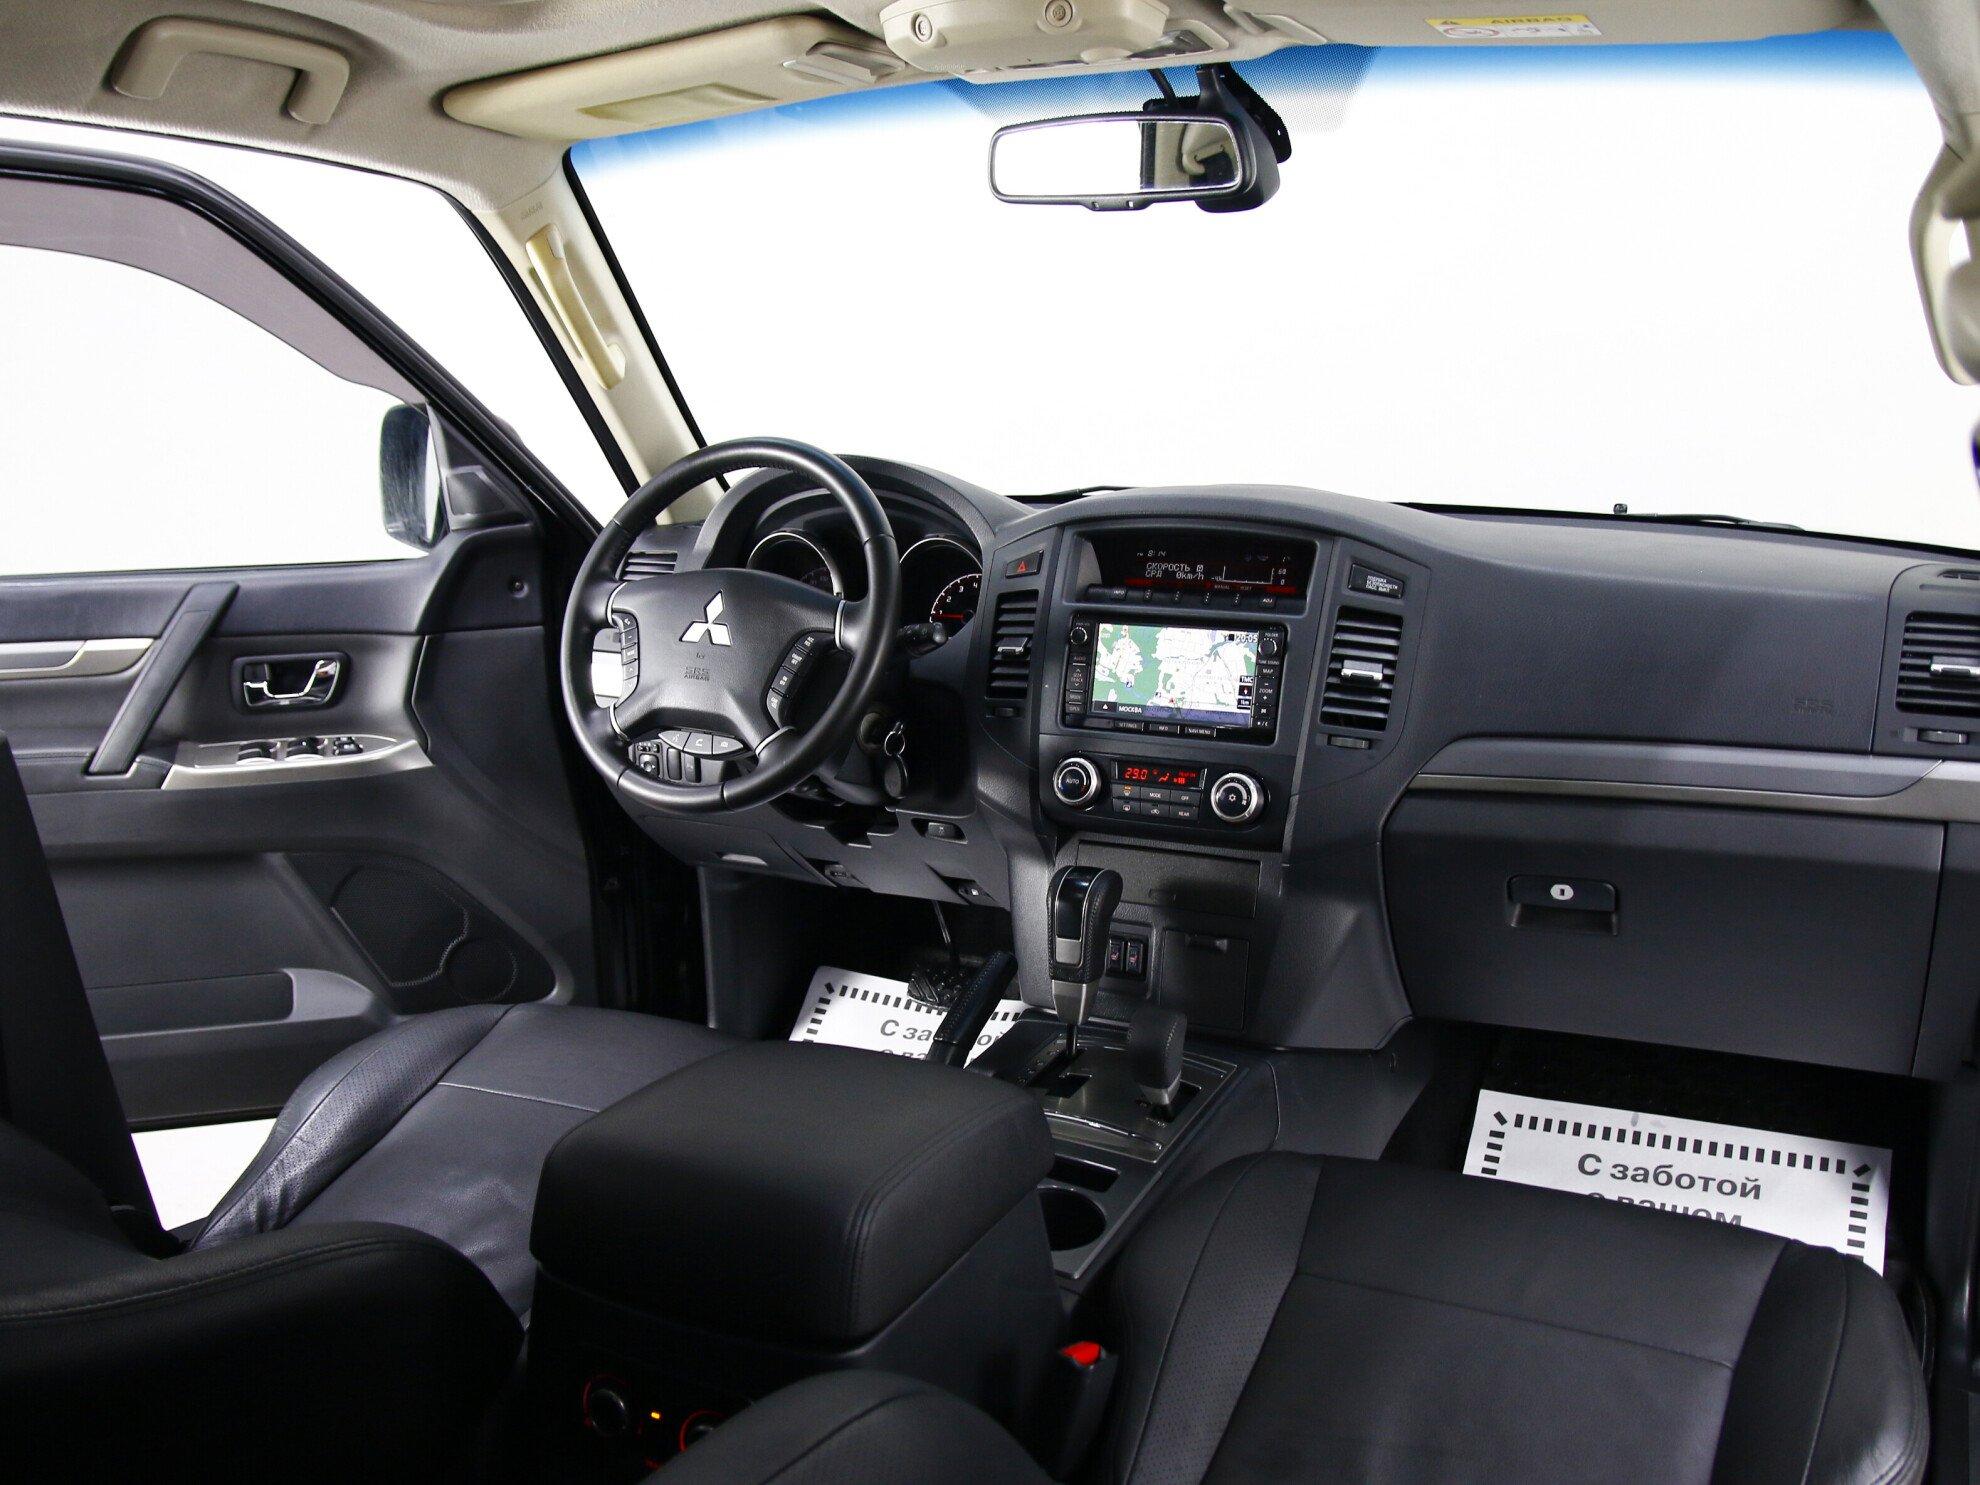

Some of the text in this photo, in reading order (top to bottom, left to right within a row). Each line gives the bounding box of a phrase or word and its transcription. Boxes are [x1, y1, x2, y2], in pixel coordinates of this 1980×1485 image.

[1146, 562, 1191, 572] СКОРОСТЬ
[946, 595, 952, 603] 2
[1118, 705, 1142, 714] МОСКВА
[880, 1019, 900, 1037] С
[1577, 1153, 1762, 1200] С заботой
